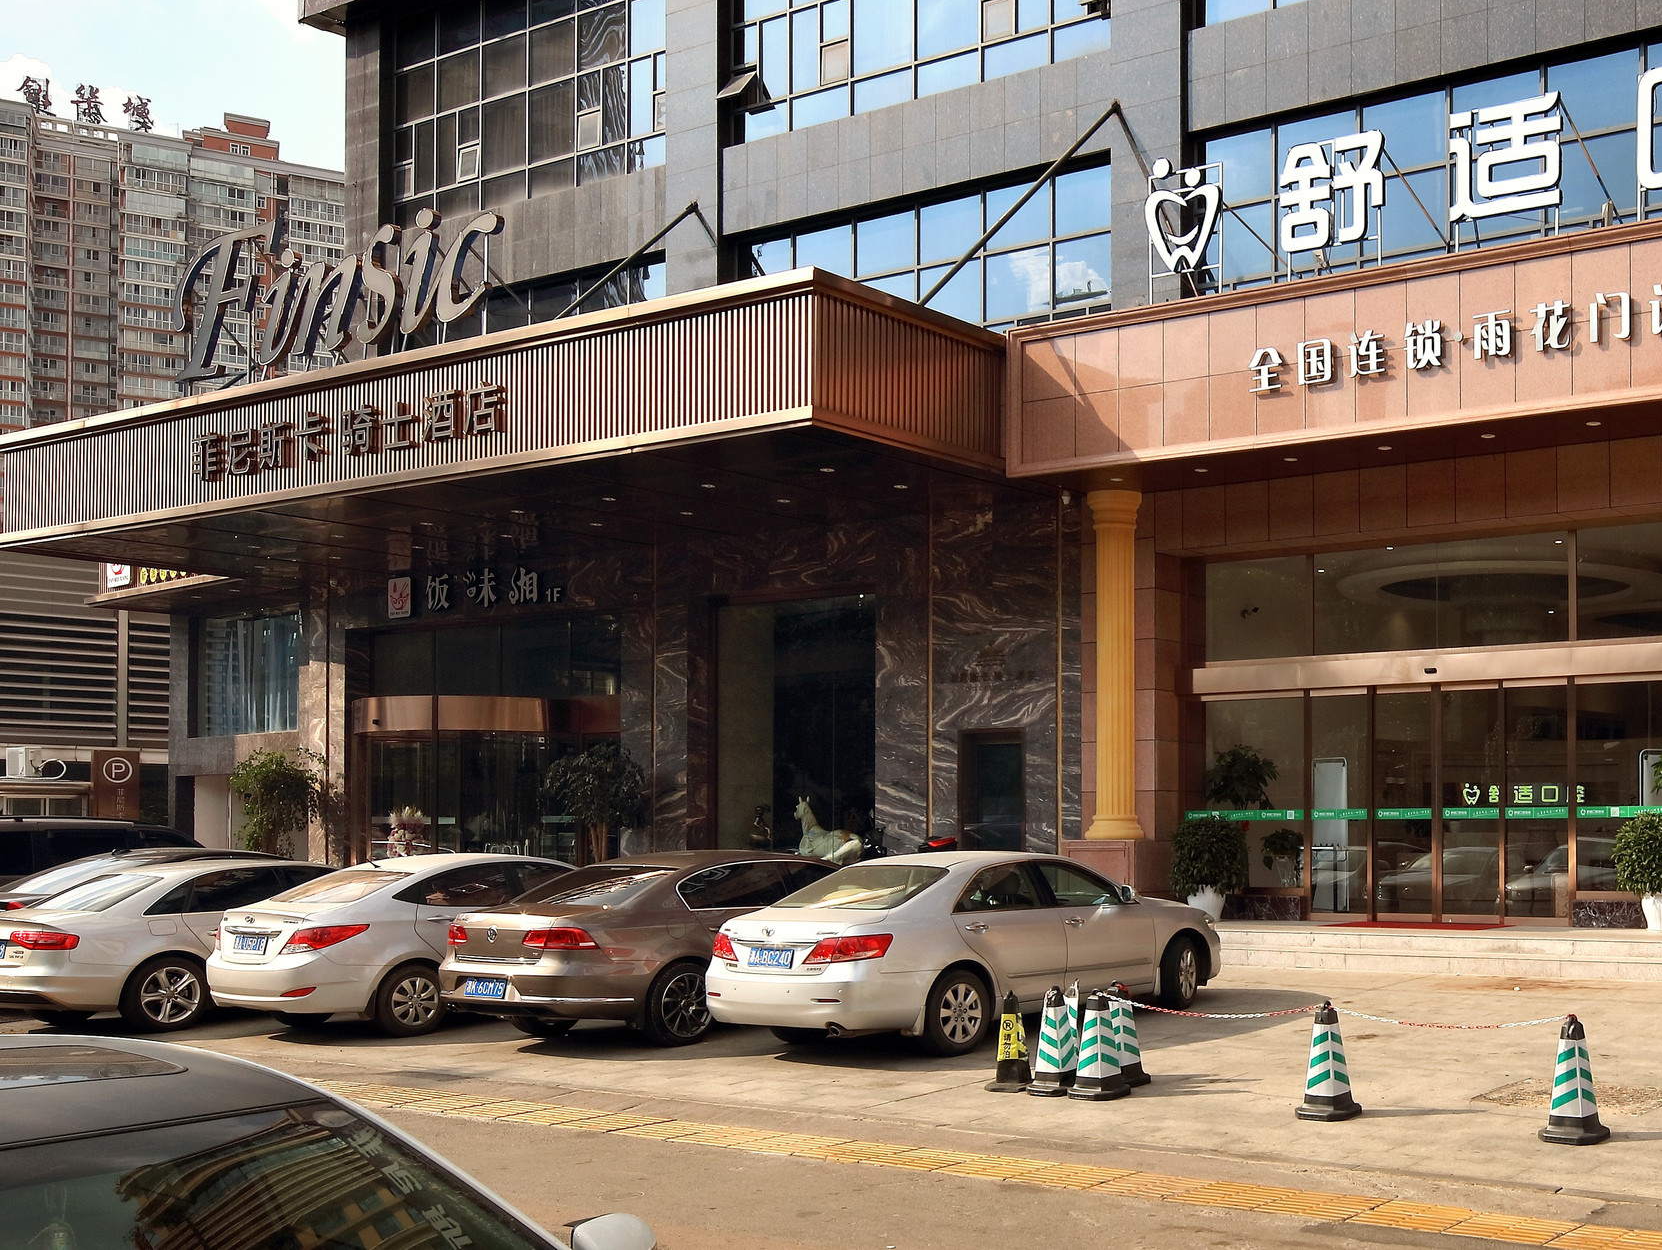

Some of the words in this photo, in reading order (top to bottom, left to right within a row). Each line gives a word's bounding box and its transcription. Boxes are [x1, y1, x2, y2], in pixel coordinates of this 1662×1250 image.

[174, 207, 505, 384] Finsic
[425, 567, 538, 611] 饭味湘
[545, 587, 562, 603] 1F
